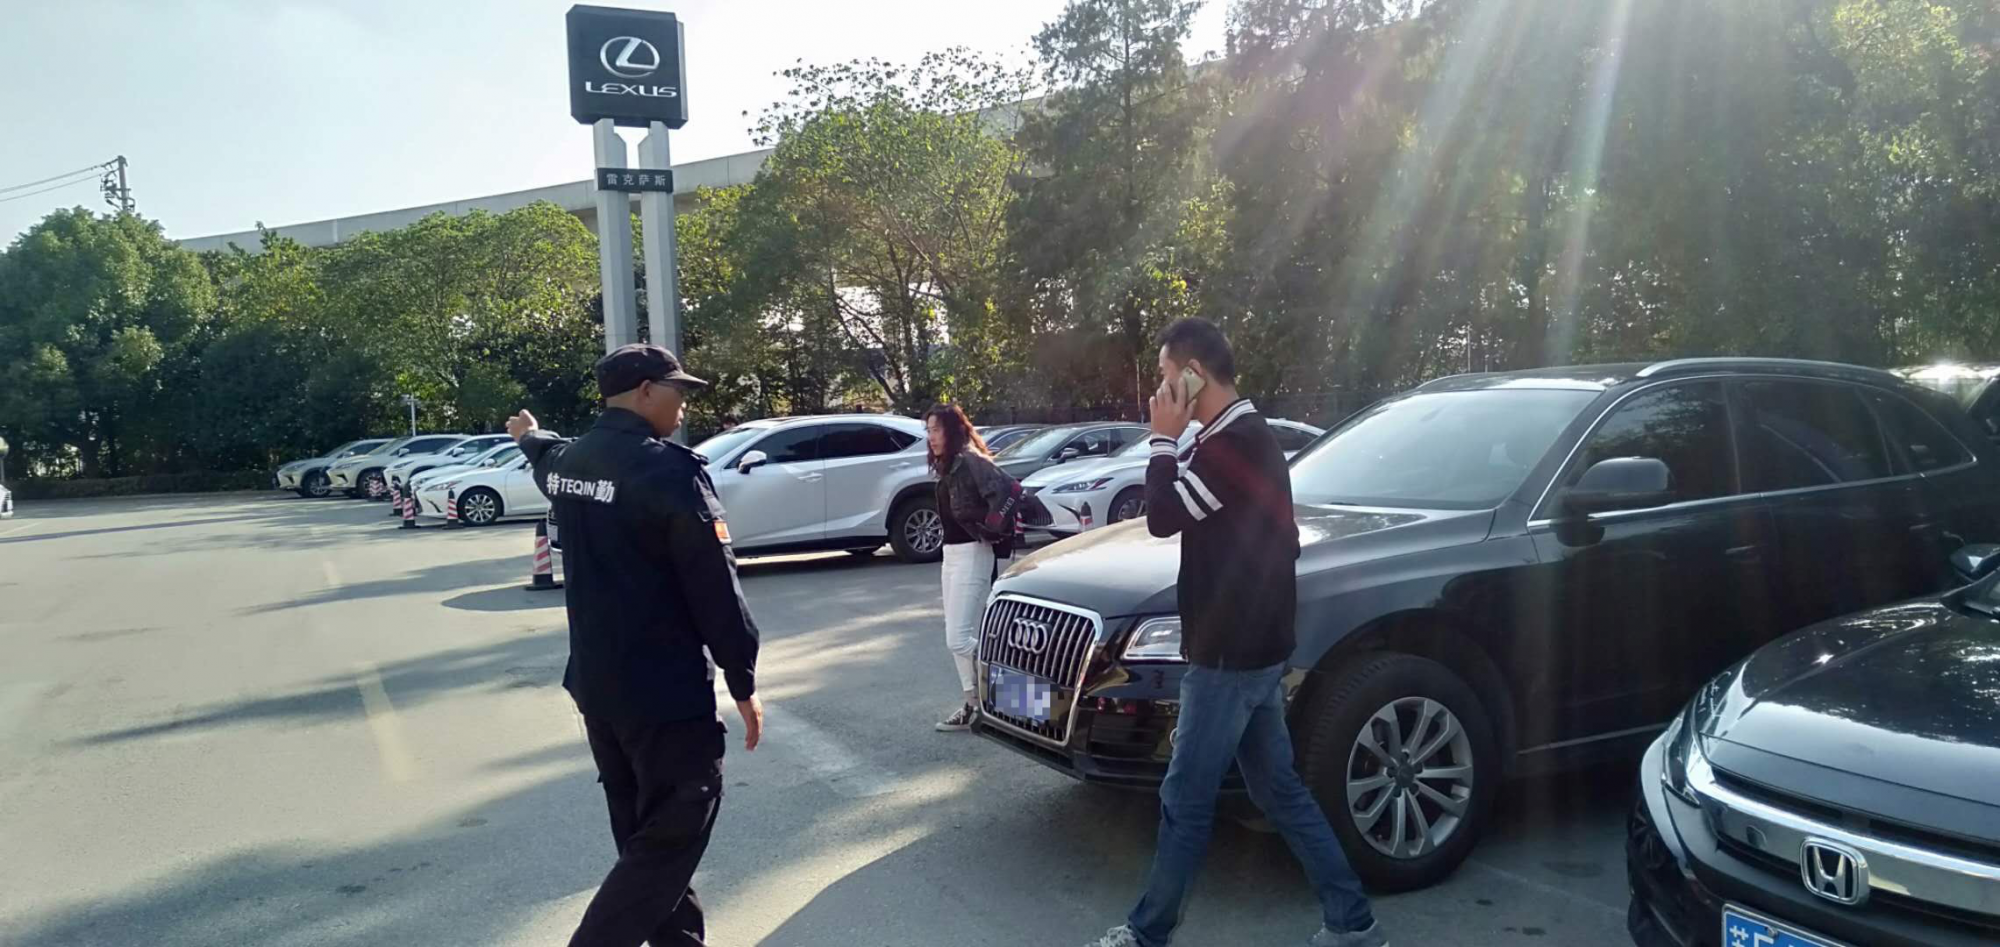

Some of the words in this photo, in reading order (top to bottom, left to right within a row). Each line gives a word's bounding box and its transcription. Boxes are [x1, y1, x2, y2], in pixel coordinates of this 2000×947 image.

[585, 81, 677, 98] LEXUS
[606, 173, 666, 186] 雷克萨斯
